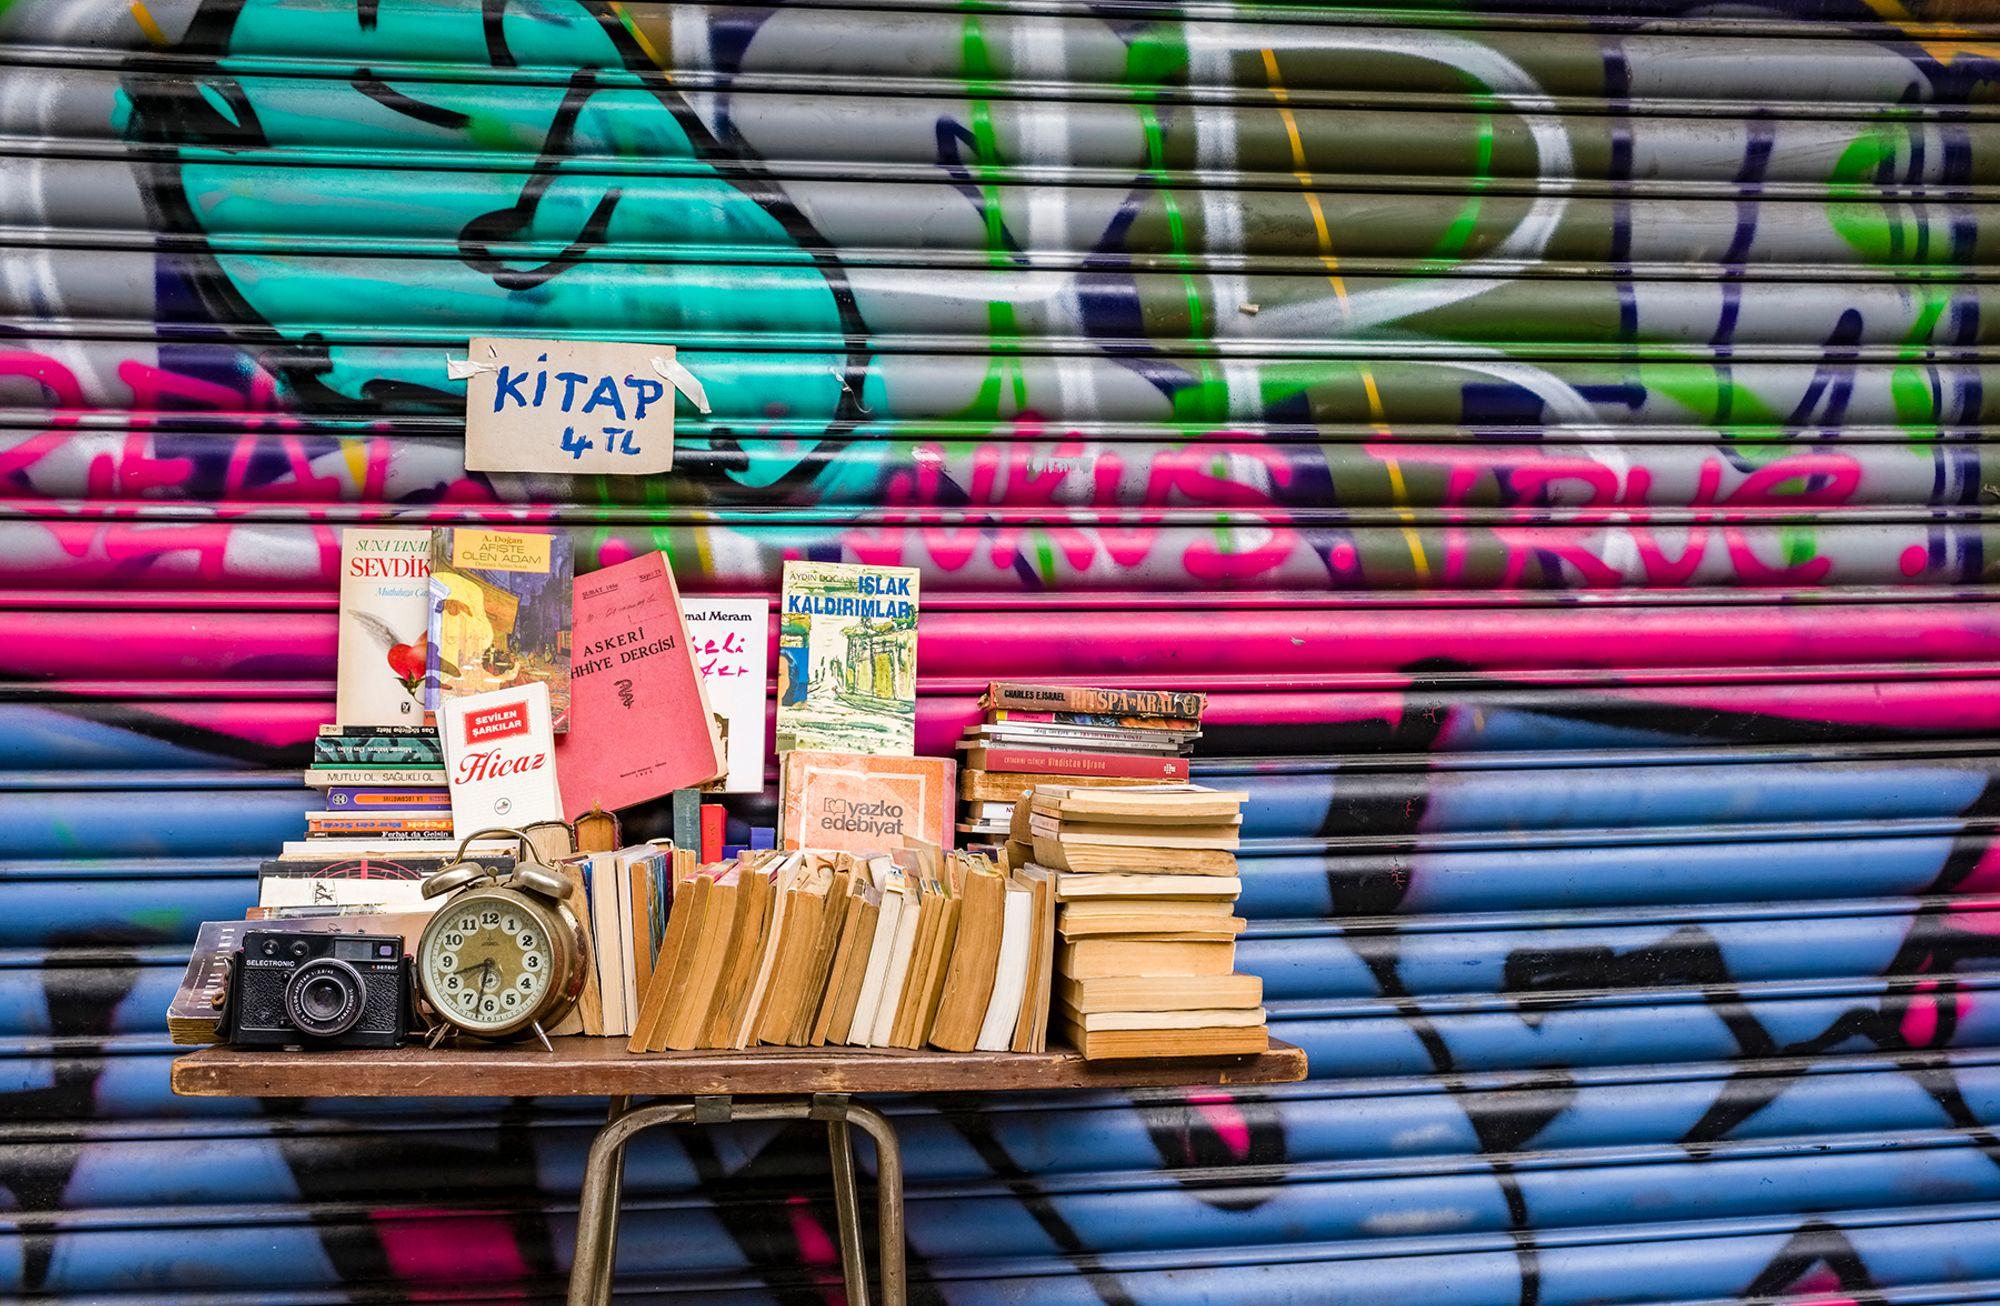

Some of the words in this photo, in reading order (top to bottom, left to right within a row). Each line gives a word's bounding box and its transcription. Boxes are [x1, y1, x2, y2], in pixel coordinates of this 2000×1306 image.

[494, 353, 663, 420] KİTAP
[560, 426, 593, 459] 4
[602, 427, 641, 456] TL
[494, 536, 523, 544] Doğan
[502, 554, 542, 564] ADAM
[350, 555, 431, 578] SEVDİK
[858, 576, 910, 596] ISLAK
[788, 595, 910, 619] KALDIRIMLAR
[709, 611, 752, 621] Meram
[584, 626, 644, 657] ASKERİ
[620, 635, 675, 664] DERGİSİ
[1004, 690, 1034, 700] CHARLES
[475, 710, 517, 725] SEVİLEN
[472, 720, 522, 737] ŞARKILAR
[455, 748, 547, 785] Hicaz
[327, 773, 360, 781] MUTLU
[423, 773, 434, 781] OL
[847, 800, 903, 818] yazko
[821, 815, 903, 837] edebiyat
[462, 919, 477, 930] 11
[482, 913, 499, 924] 12
[508, 919, 515, 930] 1
[445, 934, 462, 945] 10
[522, 935, 533, 946] 2
[443, 956, 453, 967] 9
[528, 956, 538, 968] 3
[448, 977, 458, 989] 8
[521, 978, 531, 989] 4
[464, 993, 473, 1004] 7
[506, 994, 515, 1005] 5
[484, 1000, 494, 1012] 6
